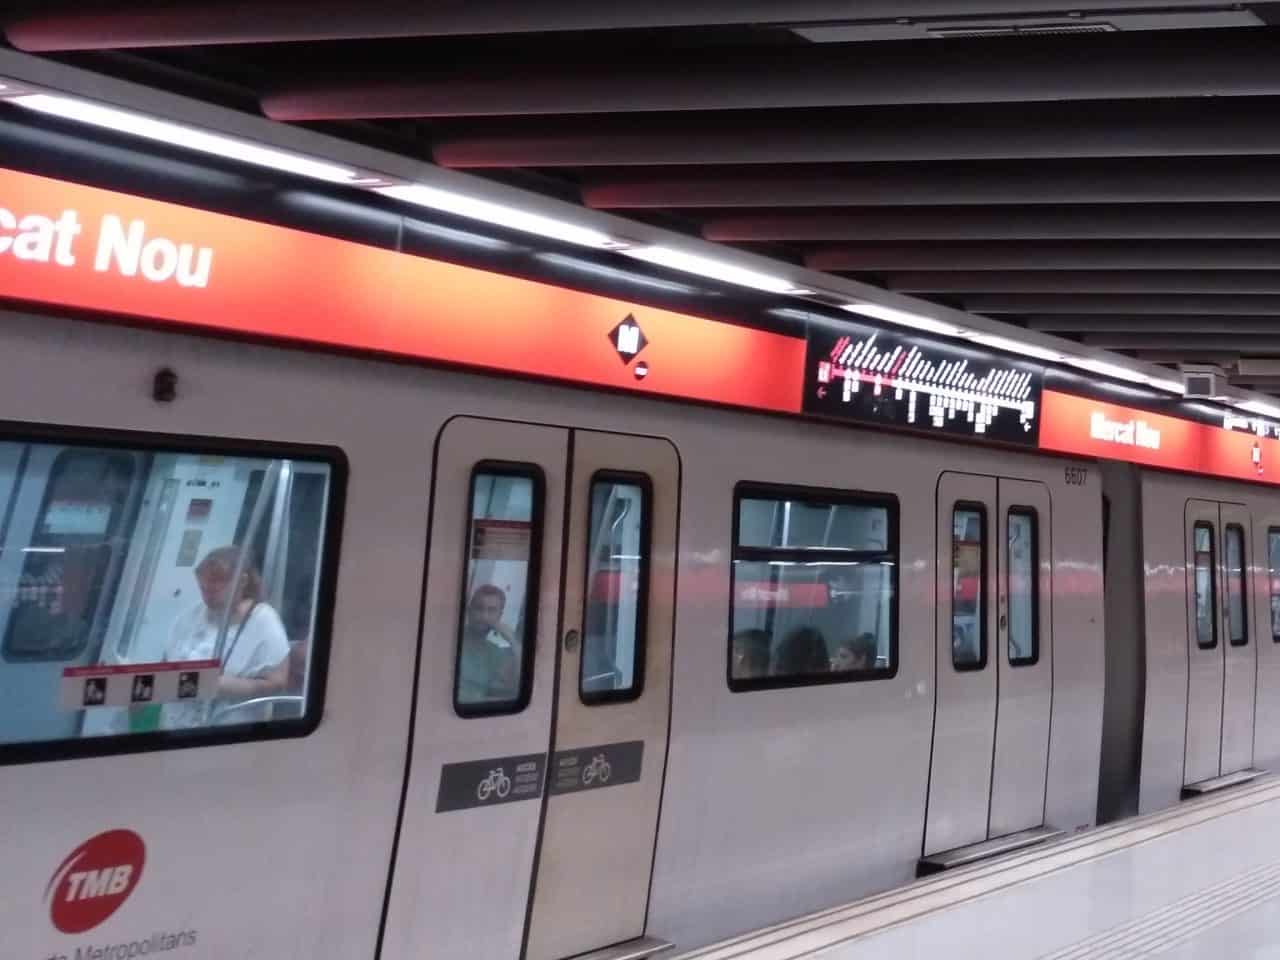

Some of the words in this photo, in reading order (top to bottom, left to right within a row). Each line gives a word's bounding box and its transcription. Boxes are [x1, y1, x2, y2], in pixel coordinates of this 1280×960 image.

[94, 213, 214, 289] Nou
[65, 864, 134, 903] TMB
[74, 928, 199, 960] Metropolitans
